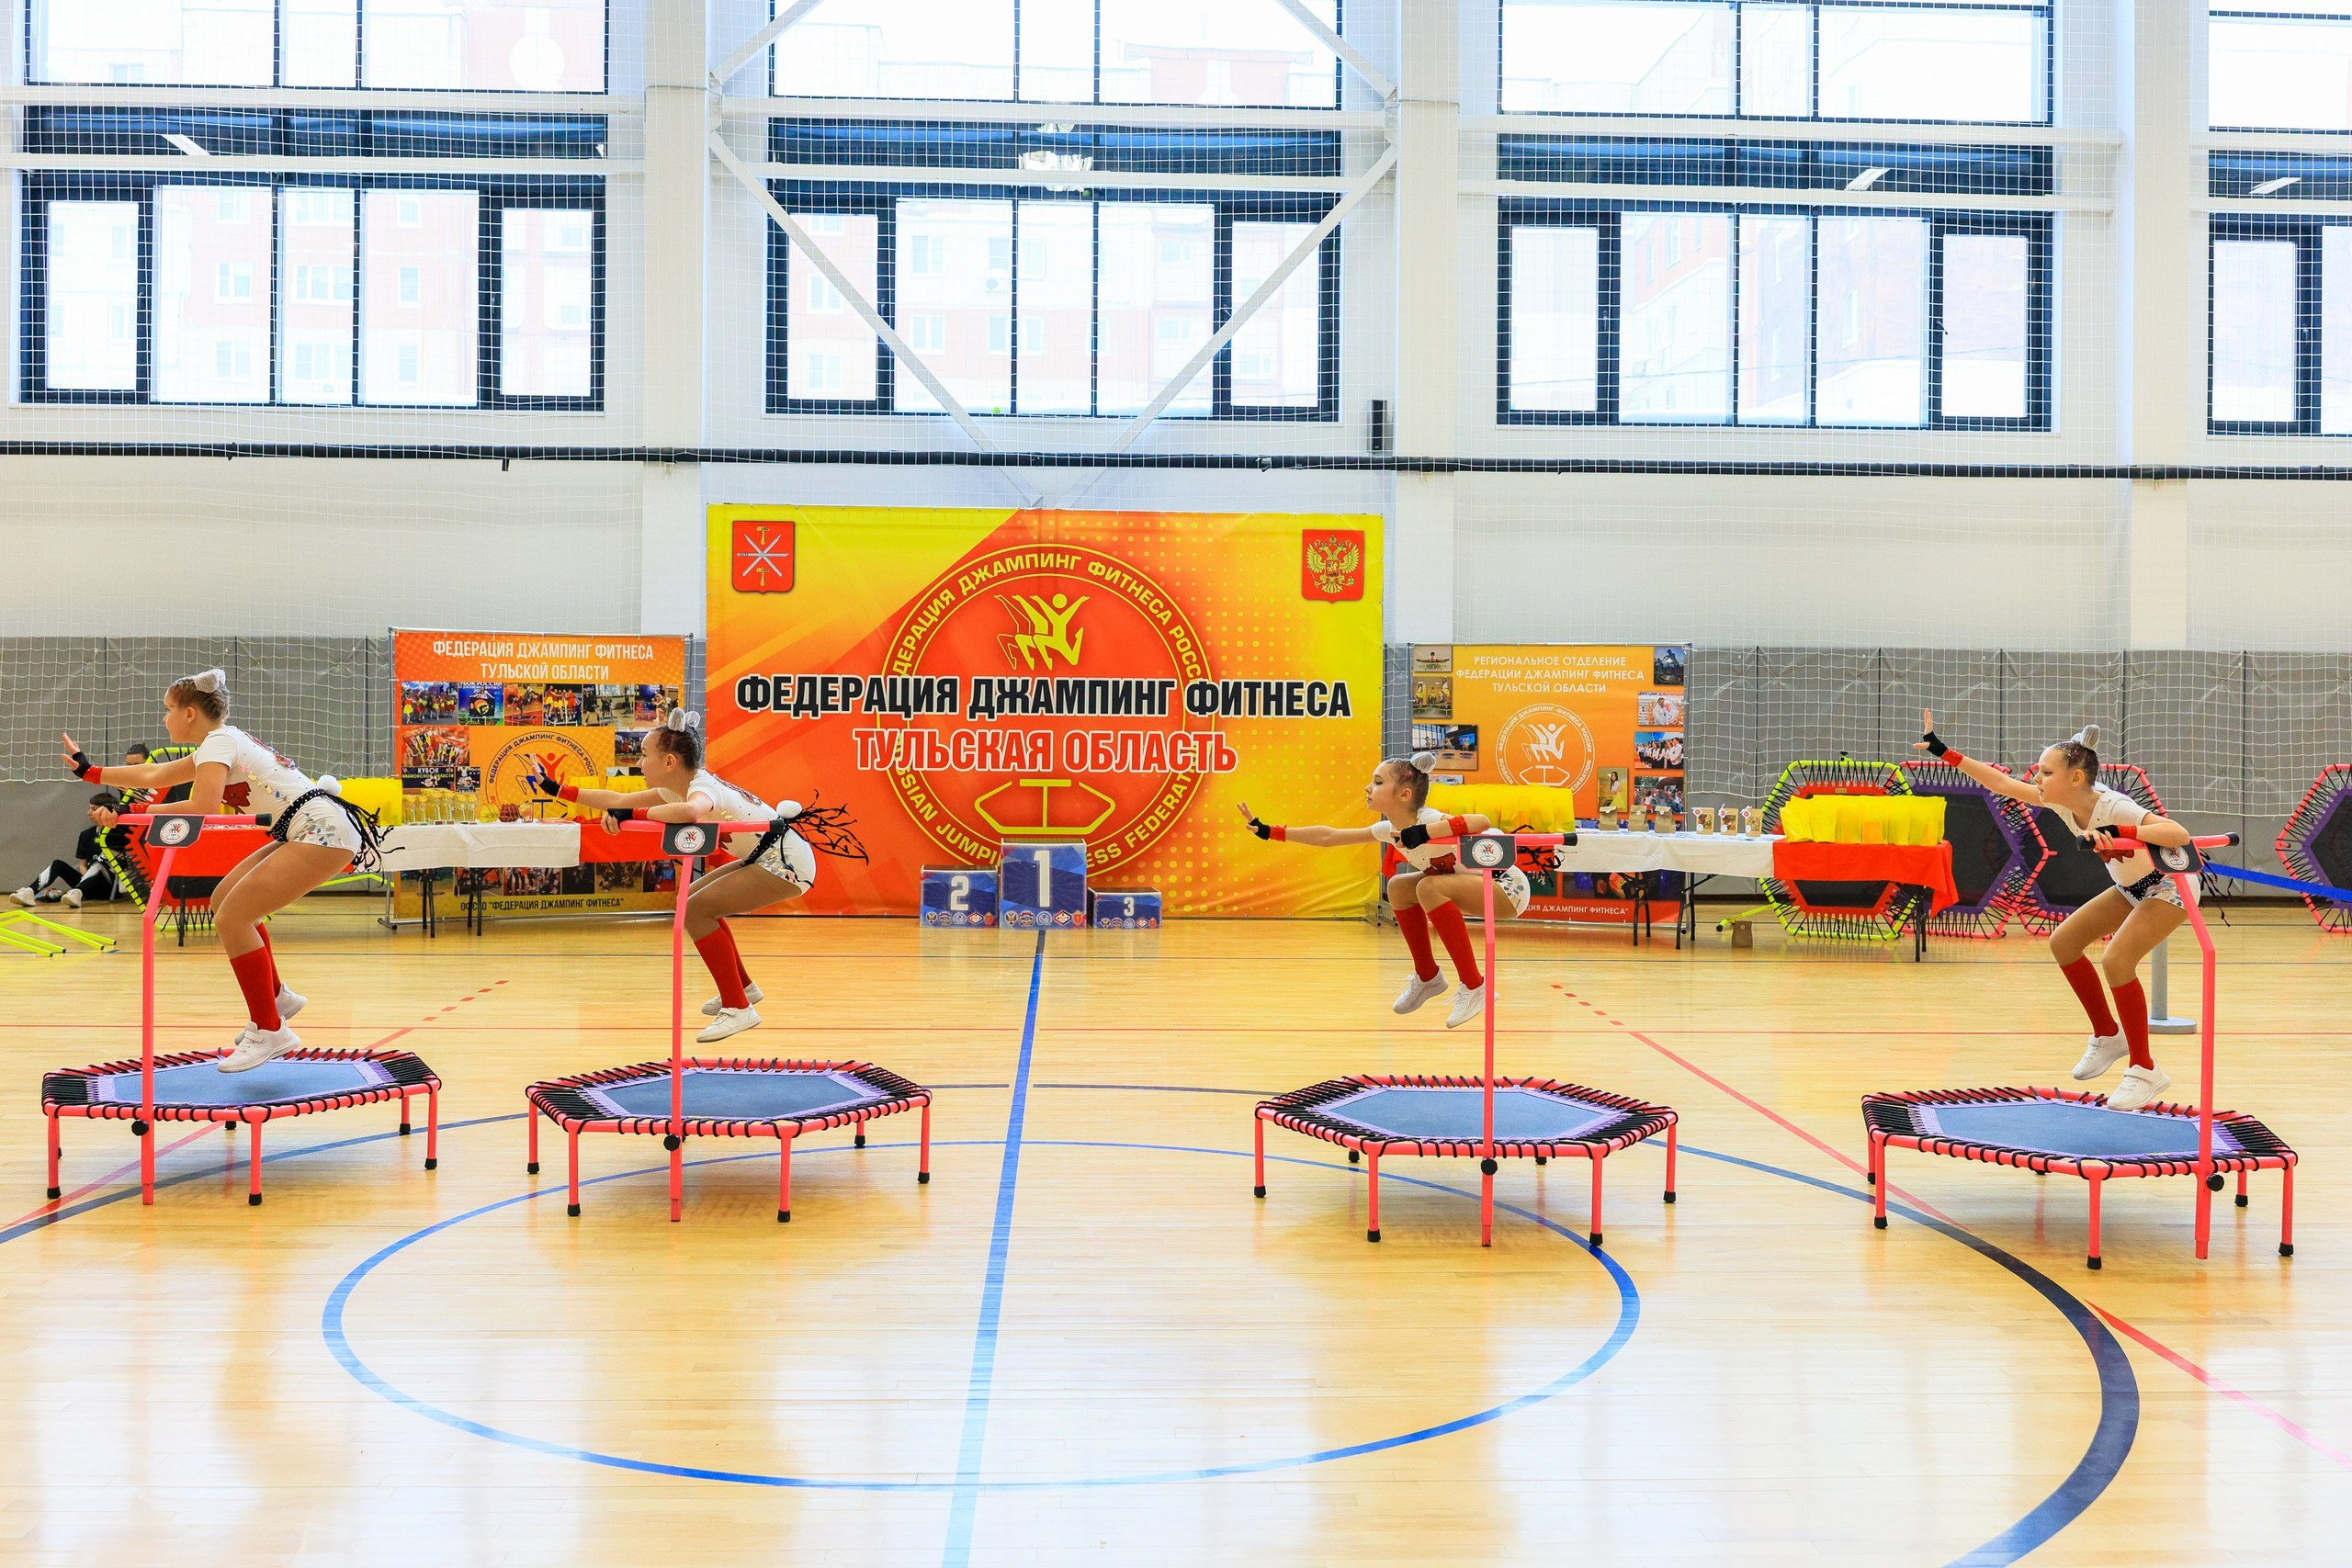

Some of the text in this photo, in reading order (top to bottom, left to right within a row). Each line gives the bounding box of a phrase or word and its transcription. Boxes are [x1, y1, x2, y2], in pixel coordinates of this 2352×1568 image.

[892, 553, 1203, 682] ДЕРАЦИЯ ДЖАМПИНГ ФИТНЕСА РОСС
[433, 640, 654, 660] ФЕДЕРАЦИЯ ДЖАМПИНГ ФИТНЕСА
[1474, 656, 1626, 667] РЕГИОНАЛЬНОЕ ОТДЕЛЕНИЕ
[480, 661, 609, 681] ТУЛЬСКОЙ ОБЛАСТИ
[1456, 669, 1645, 681] ФЕДЕРАЦИИ ДЖАМПИНГ ФИТНЕСА
[736, 674, 1353, 721] ФЕДЕРАЦИЯ ДЖАМПИНГ ФИТНЕСА
[1492, 681, 1606, 694] ТУЛЬСКОЙ ОБЛАСТИ
[488, 734, 595, 784] ФЕДЕРАЦИЯ ДЖАМПИНГ ФИТНЕСА РОСС
[853, 728, 1239, 774] ТУЛЬСКАЯ ОБЛАСТЬ
[1570, 759, 1592, 792] EDERATION
[935, 823, 1001, 867] JUMPI
[1033, 850, 1050, 908] 1
[489, 899, 539, 911] "ФЕДЕРАЦИЯ
[540, 898, 585, 910] ДЖАМПИНГ
[586, 897, 625, 908] ФИТНЕСА"
[950, 875, 970, 911] 2
[1124, 897, 1135, 917] 3
[1589, 907, 1629, 916] ФИТНЕСА"
